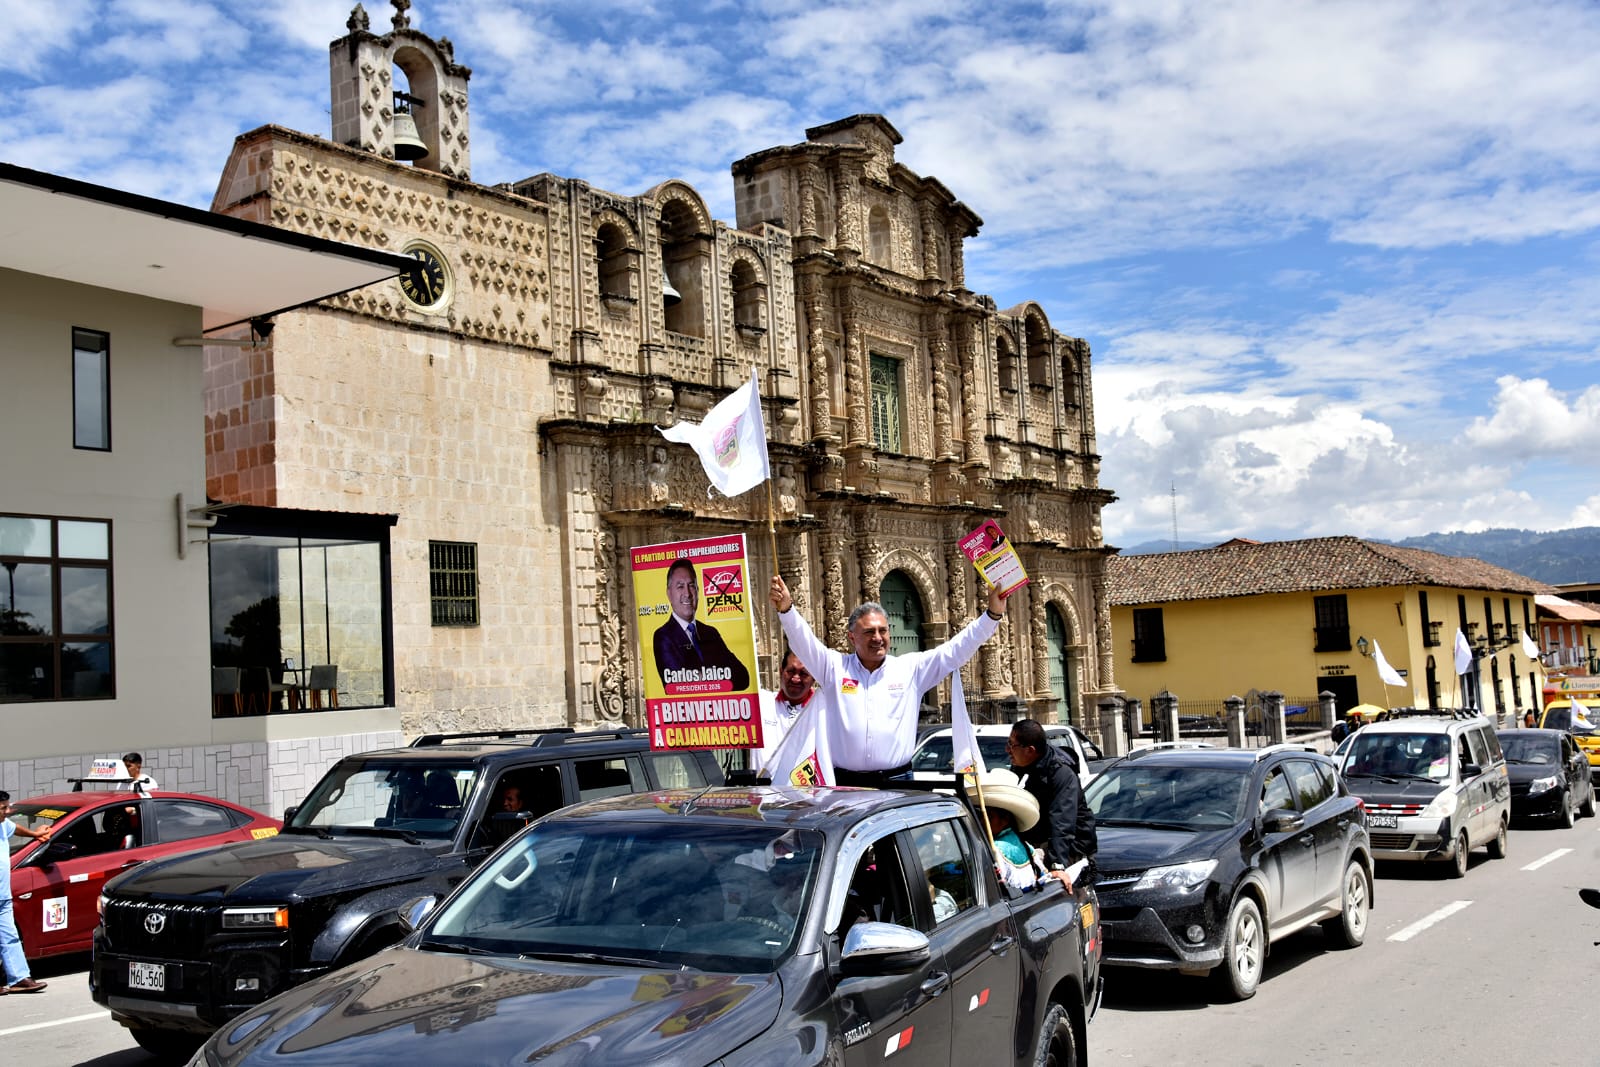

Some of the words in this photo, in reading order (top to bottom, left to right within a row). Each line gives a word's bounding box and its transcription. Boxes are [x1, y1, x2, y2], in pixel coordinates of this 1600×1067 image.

[635, 554, 641, 563] EL
[641, 551, 666, 562] PARTIDO
[666, 550, 677, 559] DEL
[677, 548, 689, 558] LOS
[688, 542, 740, 557] EMPRENDEDORES
[706, 592, 742, 607] PERÚ
[663, 667, 700, 684] Carlos
[701, 665, 732, 681] Jaico
[676, 684, 708, 692] PRESIDENTE
[655, 728, 665, 748] A
[130, 969, 164, 988] M6L-560
